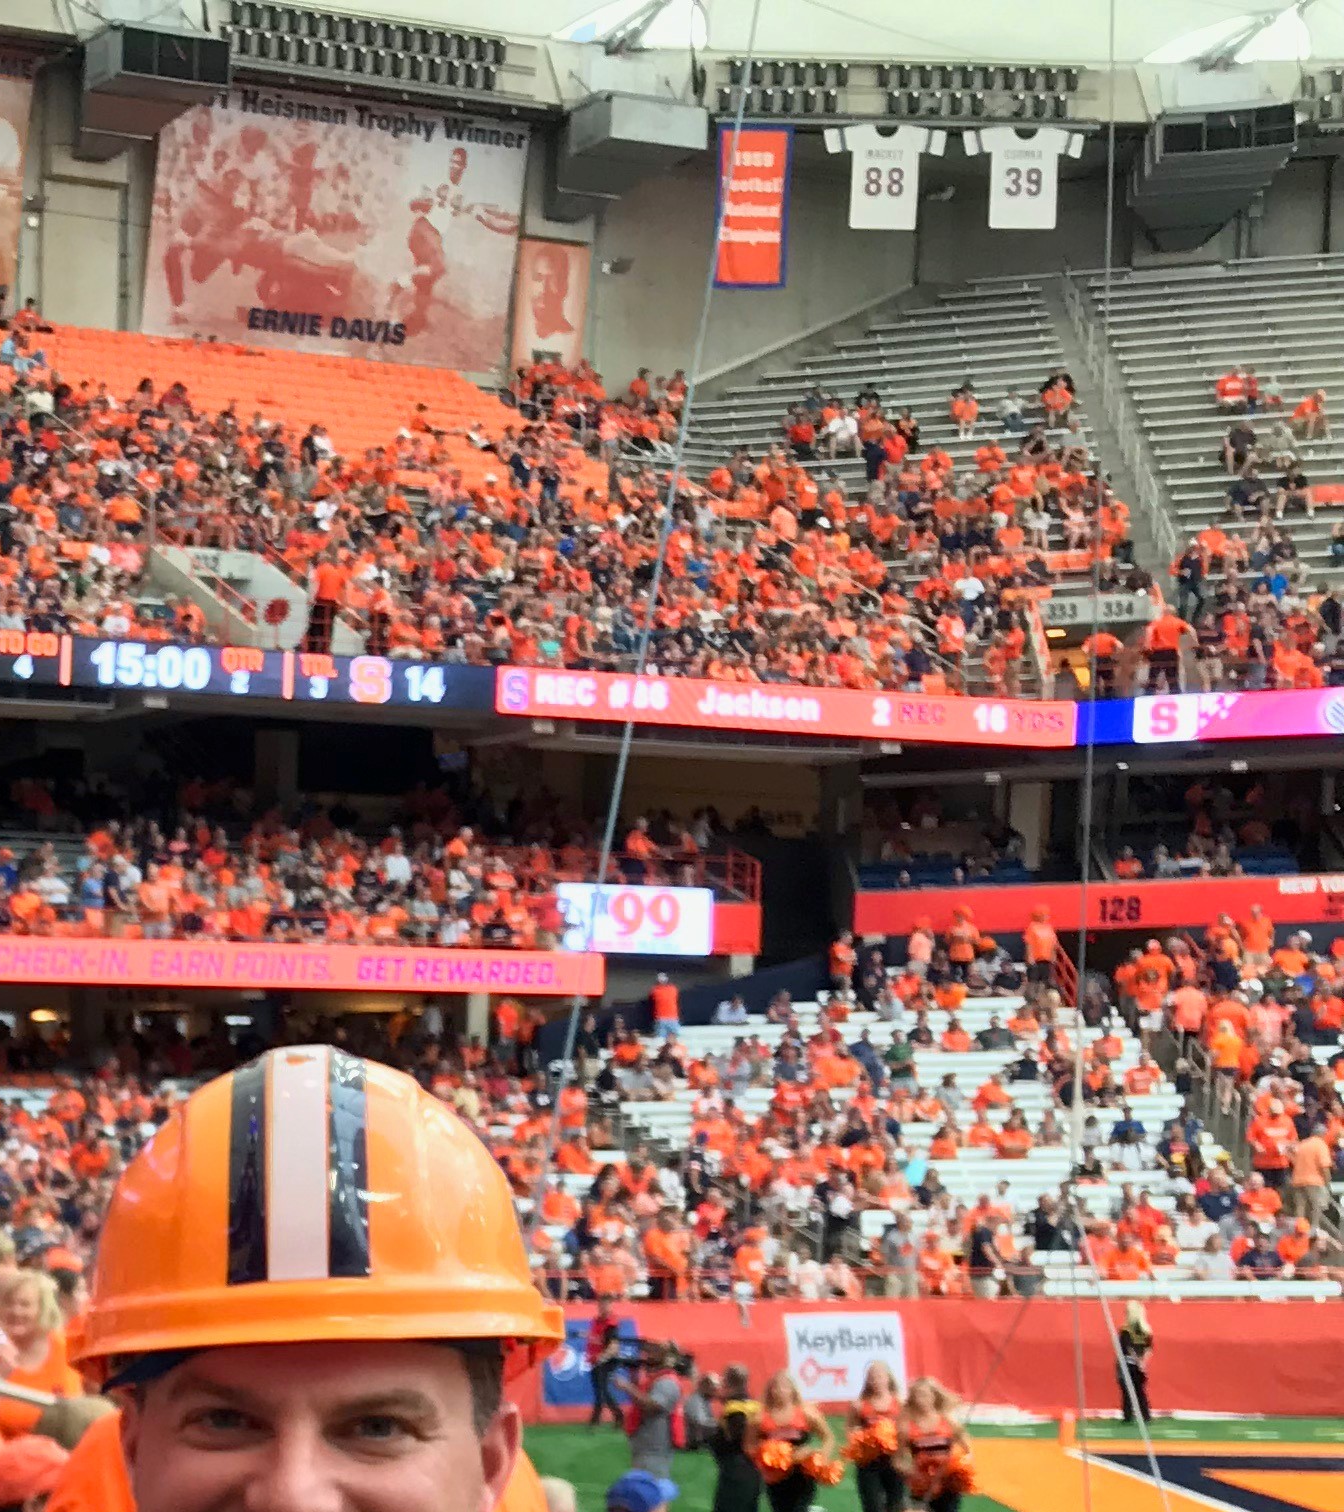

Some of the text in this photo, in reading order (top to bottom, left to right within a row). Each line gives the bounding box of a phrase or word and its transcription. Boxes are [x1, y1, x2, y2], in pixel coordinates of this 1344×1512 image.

[241, 89, 347, 125] Heisman
[353, 103, 437, 143] Trophy
[443, 115, 527, 149] Winner
[864, 167, 905, 197] 88
[1004, 167, 1043, 197] 39
[247, 306, 407, 346] ERNIE DAVIS
[13, 654, 34, 679] 4
[90, 642, 211, 690] 15:00
[404, 665, 446, 703] 14
[534, 674, 596, 707] REC
[697, 686, 821, 721] Jackson
[898, 702, 947, 726] REC
[1011, 707, 1065, 732] YDS
[611, 890, 681, 938] 99
[1098, 895, 1142, 923] 128
[149, 948, 226, 979] EARN
[357, 956, 407, 982] GET
[795, 1326, 895, 1357] KeyBank
